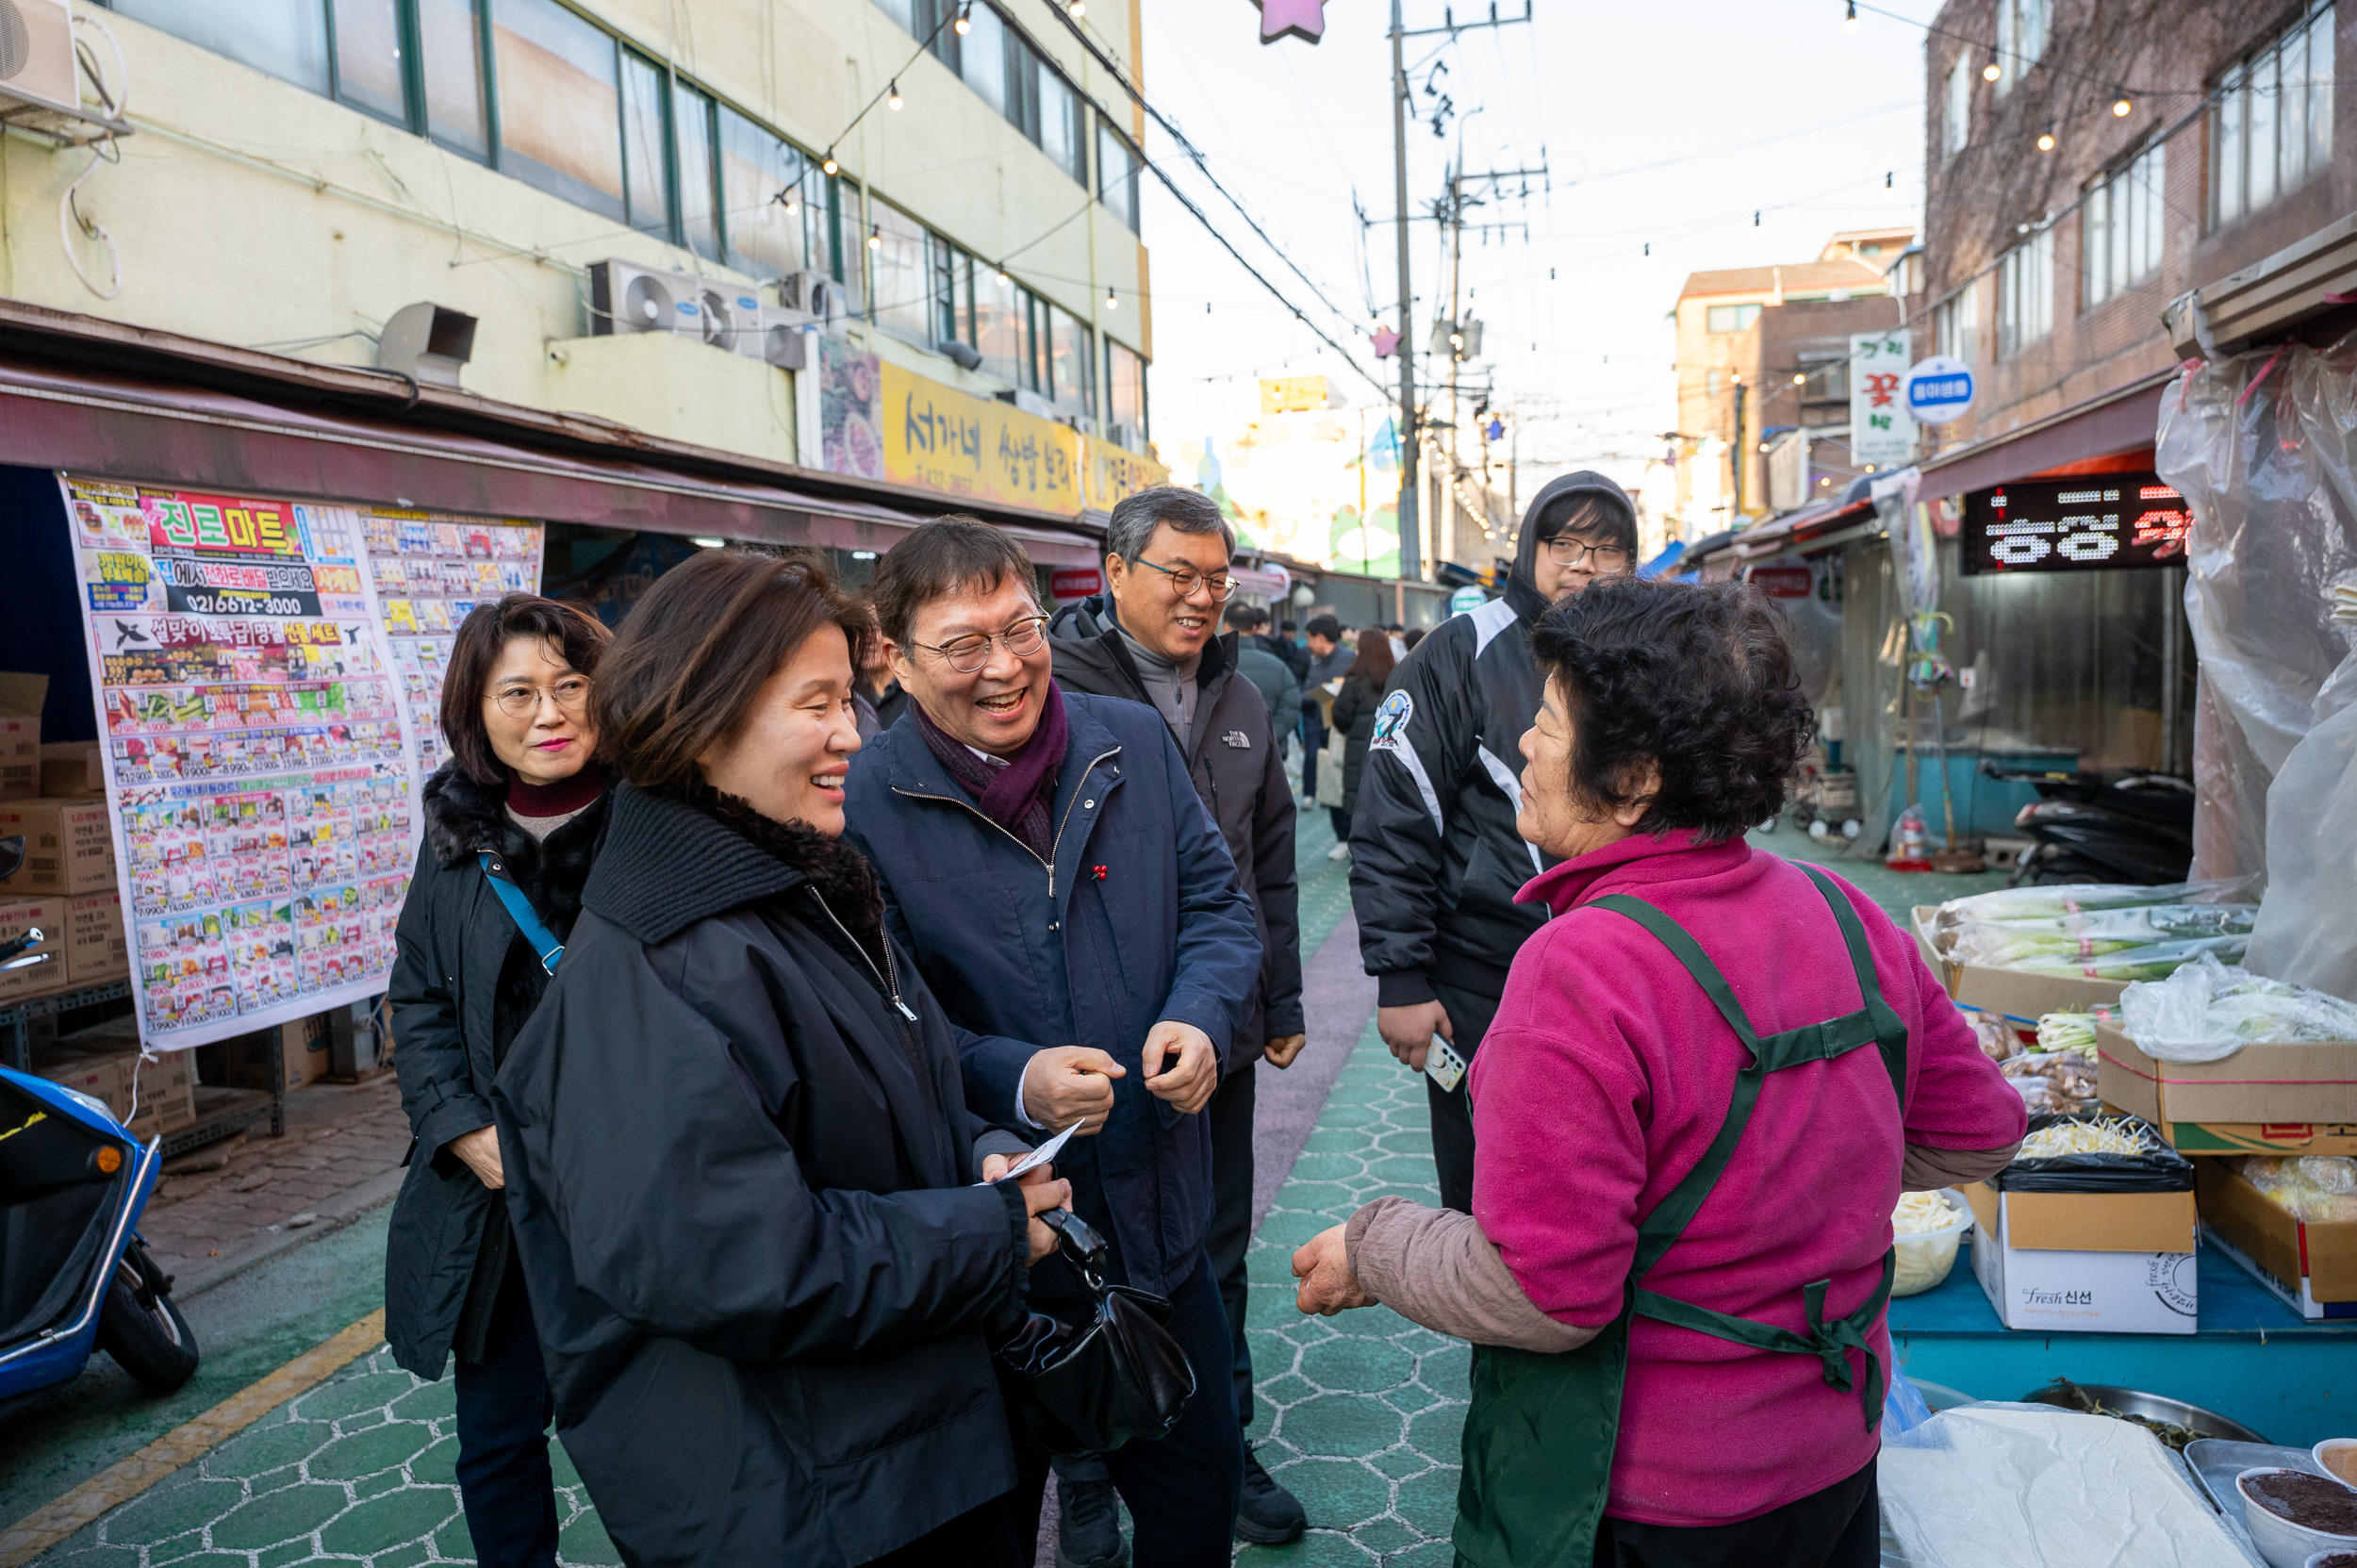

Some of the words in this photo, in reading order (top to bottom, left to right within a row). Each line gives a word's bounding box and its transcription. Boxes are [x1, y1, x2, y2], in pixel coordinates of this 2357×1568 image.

[1861, 372, 1900, 408] 꽃
[905, 390, 981, 471] 서가네
[158, 502, 289, 550] 진로마트
[151, 618, 207, 644] 설맞이
[253, 620, 285, 645] 명절
[284, 621, 311, 644] 선물
[2145, 1259, 2160, 1287] fresh
[2022, 1287, 2063, 1306] fresh
[2065, 1290, 2093, 1306] 신선
